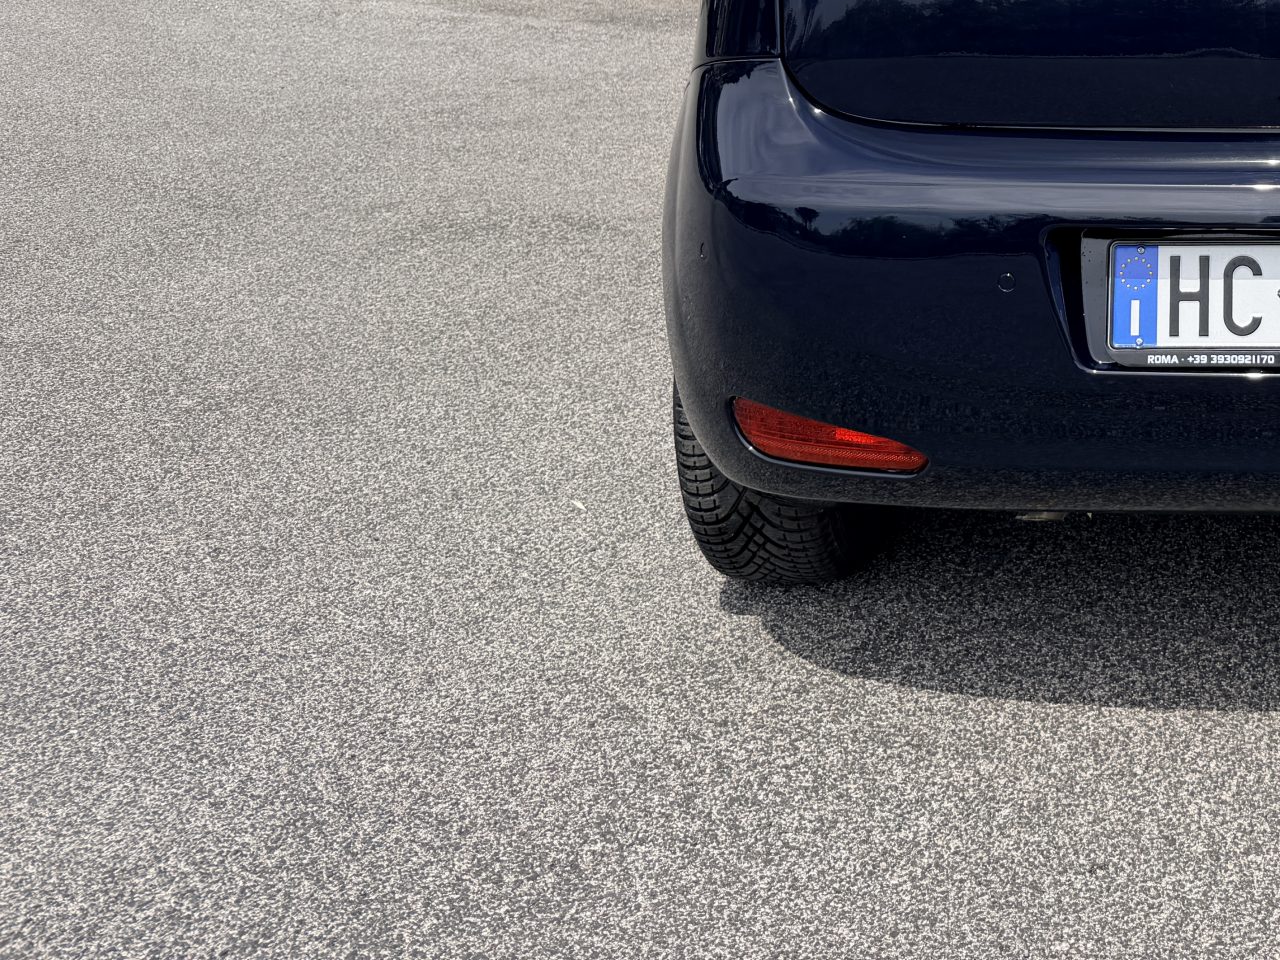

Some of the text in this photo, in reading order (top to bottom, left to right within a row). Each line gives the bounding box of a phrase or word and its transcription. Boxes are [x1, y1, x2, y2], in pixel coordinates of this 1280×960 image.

[1168, 255, 1263, 337] HC
[1147, 355, 1179, 364] ROMA
[1187, 355, 1208, 364] +39
[1210, 354, 1275, 364] 3930921170
